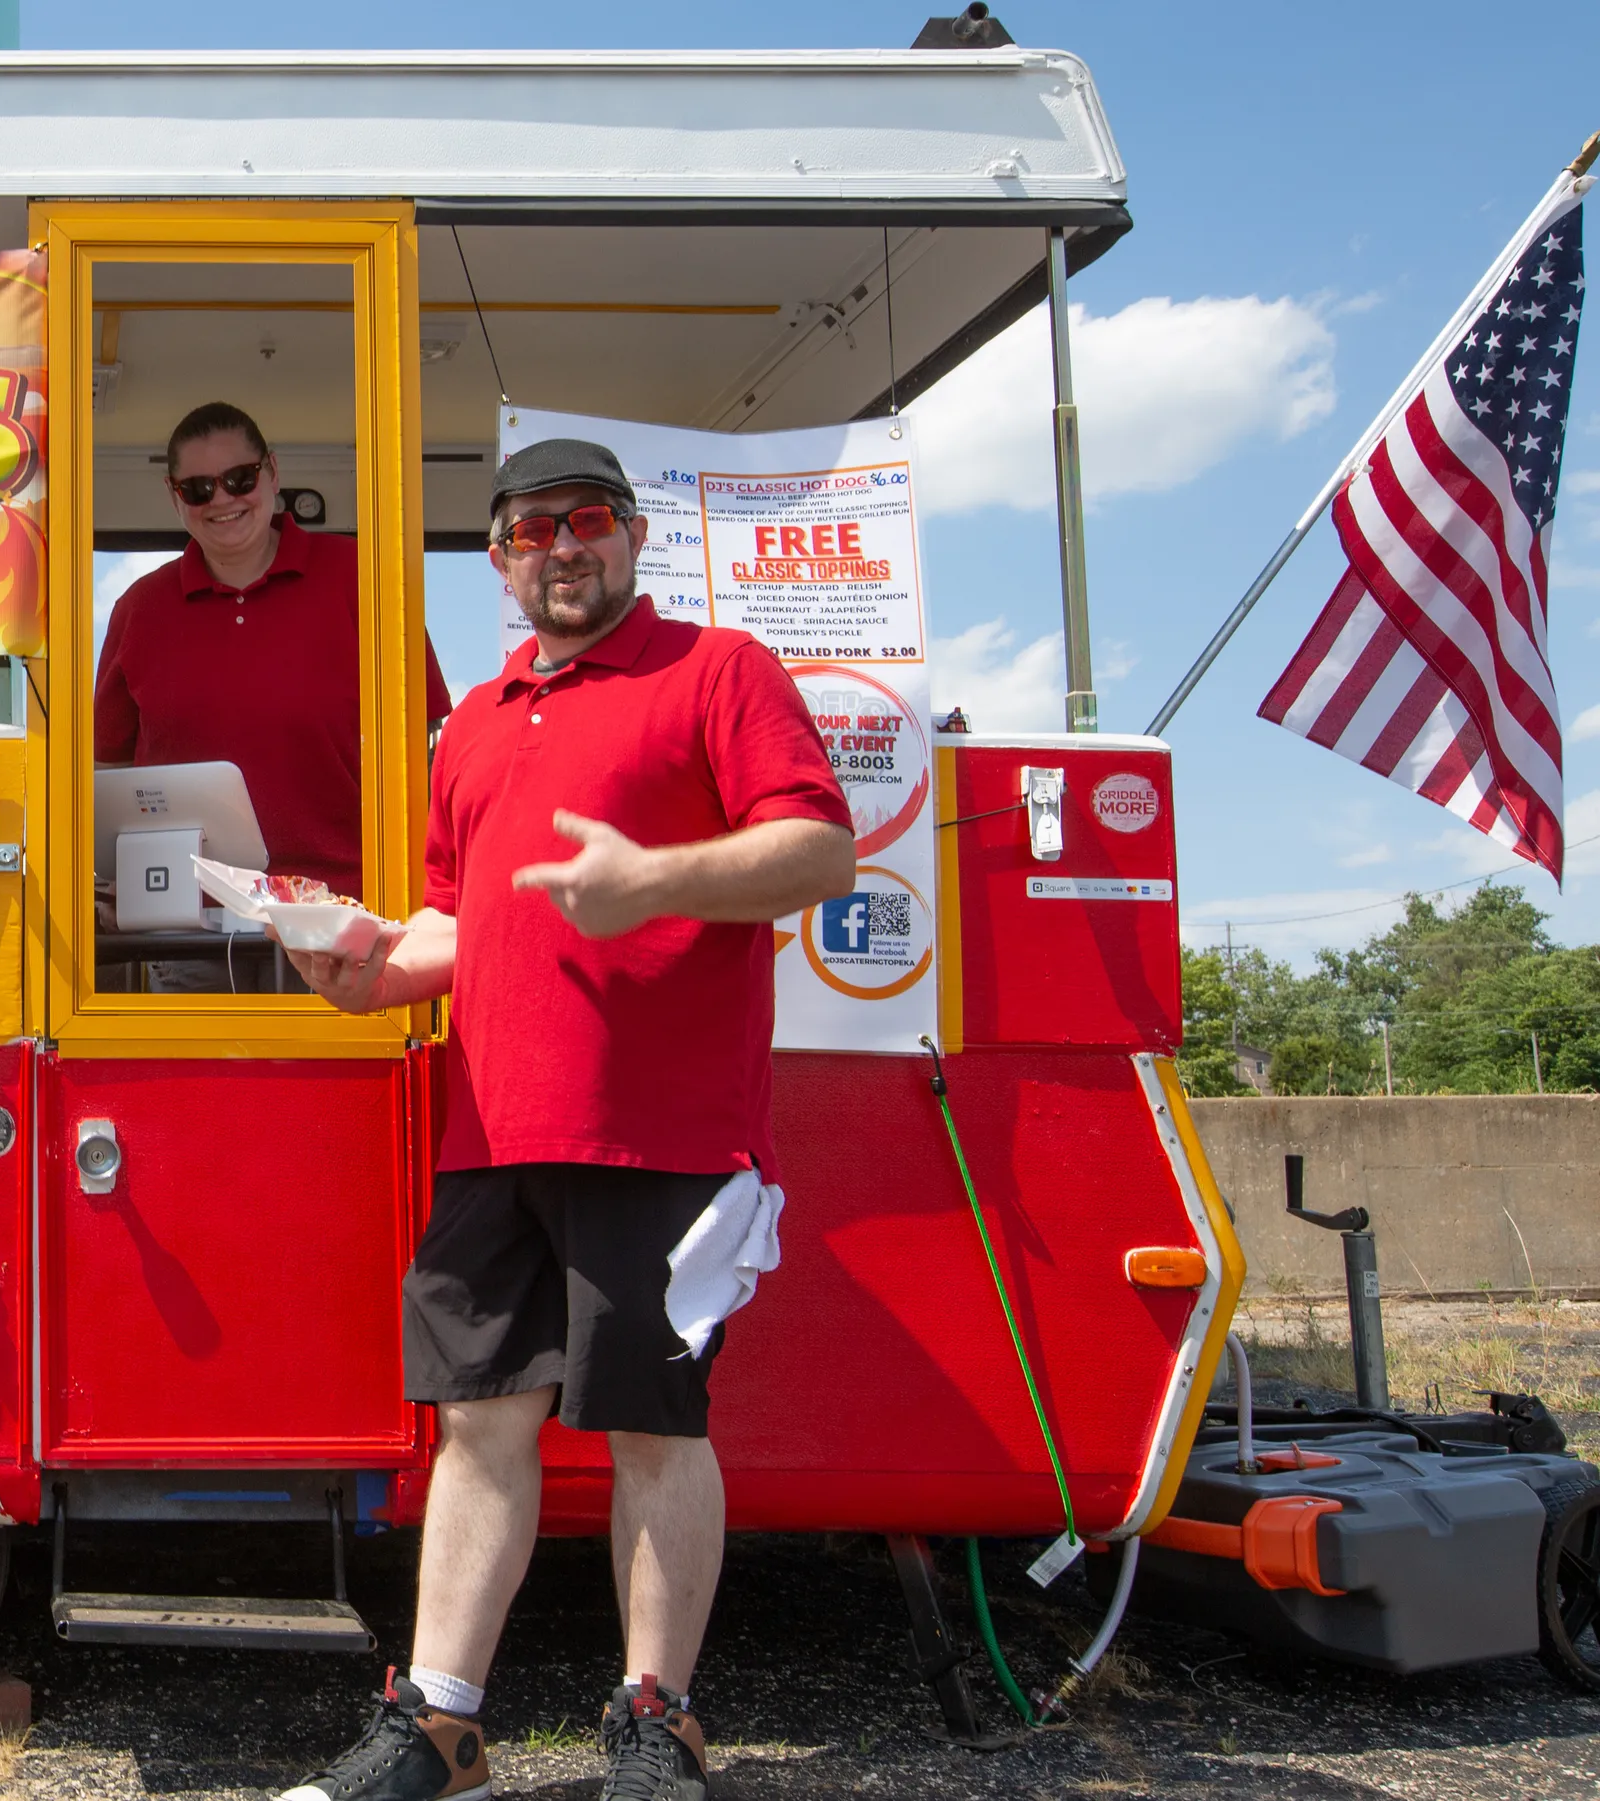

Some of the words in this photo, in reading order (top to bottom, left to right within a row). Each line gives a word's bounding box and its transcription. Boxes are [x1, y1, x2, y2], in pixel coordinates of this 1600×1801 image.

[662, 470, 696, 485] $8.00
[706, 481, 734, 492] DJ'S
[737, 480, 797, 492] CLASSIC
[800, 478, 831, 491] HOT
[835, 475, 867, 488] DOG
[638, 498, 678, 507] COLESLAW
[835, 504, 867, 513] CLASSIC
[869, 500, 908, 509] TOPPINGS
[651, 507, 681, 515] GRILLED
[817, 513, 858, 522] BUTTERED
[859, 510, 891, 519] GRILLED
[666, 532, 702, 545] $8.00
[754, 523, 862, 557] FREE
[641, 561, 671, 569] ONIONS
[731, 561, 802, 579] CLASSIC
[809, 559, 890, 579] TOPPINGS
[655, 570, 686, 578] GRILLED
[740, 583, 784, 591] KETCHUP
[791, 584, 839, 592] MUSTARD
[847, 582, 882, 591] RELISH
[669, 594, 706, 607] $8.00
[715, 593, 749, 601] BACON
[756, 594, 786, 602] DICED
[787, 594, 820, 602] ONION
[827, 592, 873, 602] SAUTÉED
[874, 592, 908, 601] ONION
[746, 605, 811, 614] SAUERKRAUT
[819, 603, 877, 614] JALAPEÑOS
[741, 616, 762, 625] BBQ
[764, 617, 796, 625] SAUCE
[803, 617, 854, 625] SRIRACHA
[855, 616, 889, 625] SAUCE
[766, 628, 827, 637] PORUBSKY'S
[828, 628, 863, 637] PICKLE
[782, 646, 833, 657] PULLED
[835, 647, 872, 658] PORK
[881, 646, 917, 658] $2.00
[857, 716, 903, 732] NEXT
[840, 735, 897, 753] EVENT
[831, 754, 895, 770] 8-8003
[836, 774, 902, 785] @GMAIL.COM
[1098, 790, 1155, 801] GRIDDLE
[1099, 801, 1156, 815] MORE
[1045, 884, 1071, 893] Square
[873, 948, 907, 956] facebook
[822, 957, 916, 967] @DJSCATERINGTOPEKA
